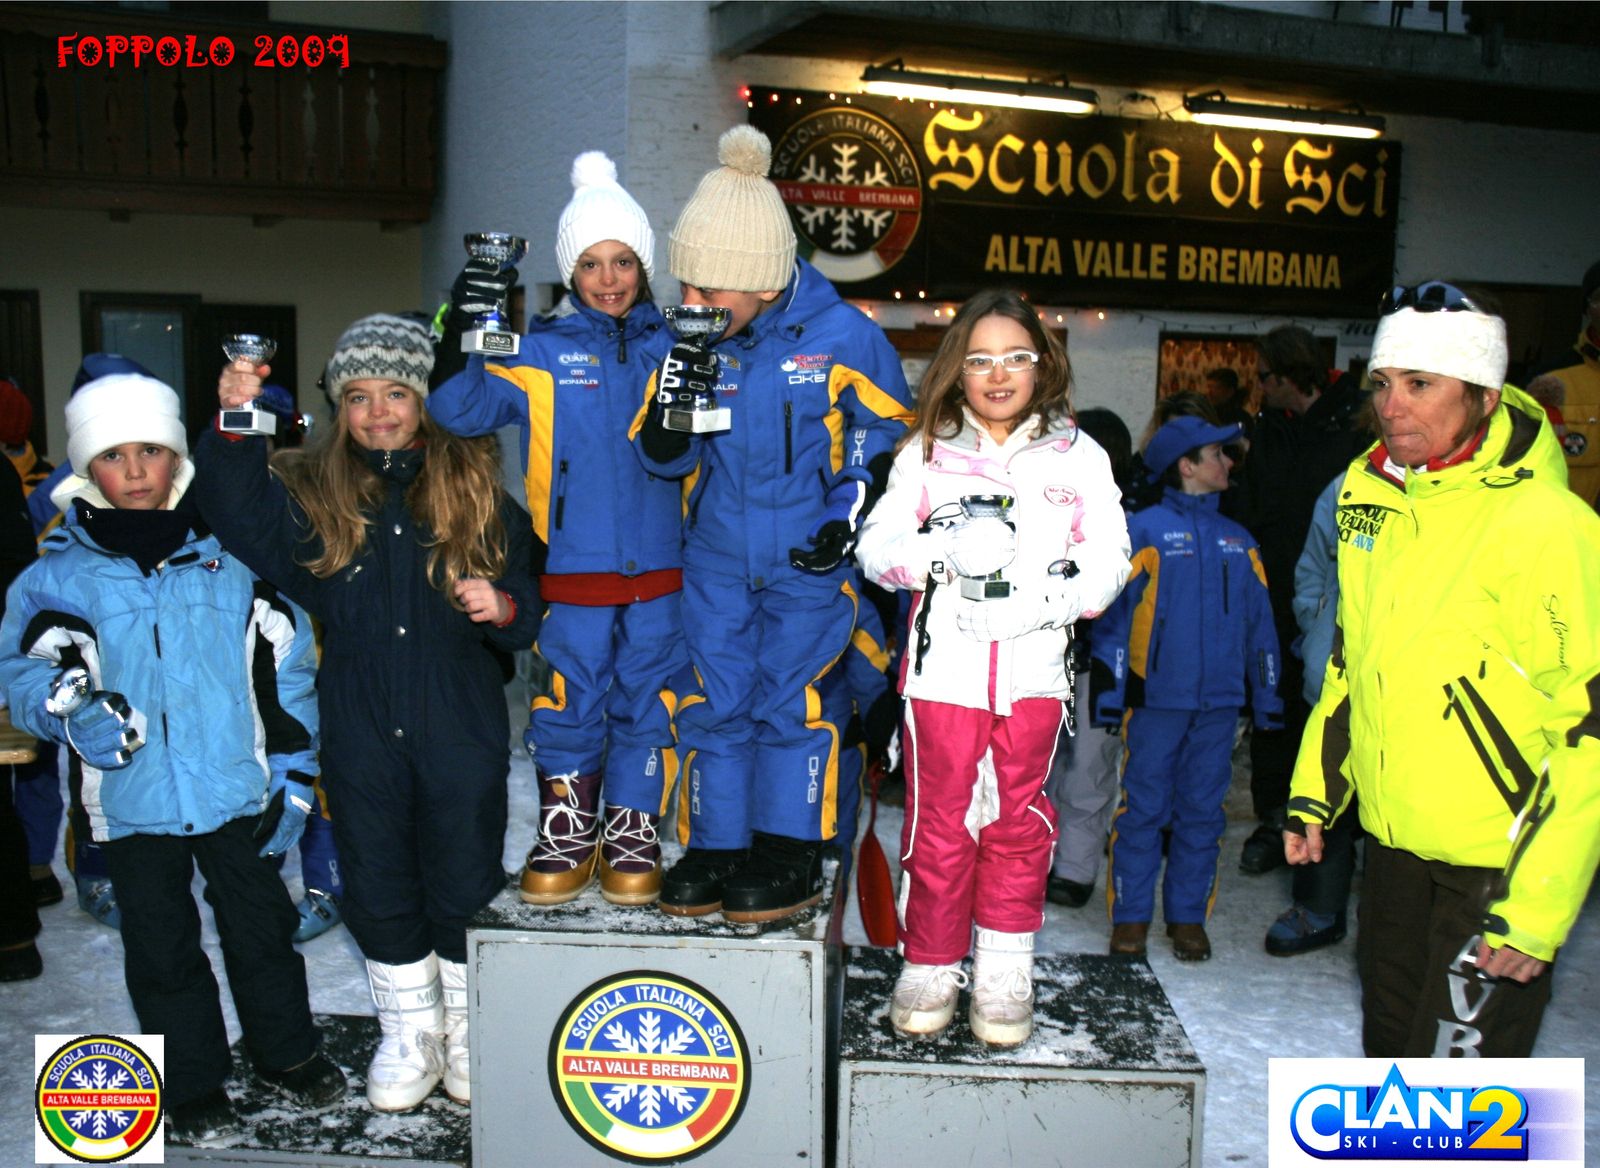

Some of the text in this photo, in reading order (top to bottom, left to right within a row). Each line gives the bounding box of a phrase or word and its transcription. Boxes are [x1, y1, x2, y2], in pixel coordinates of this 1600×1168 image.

[832, 114, 896, 152] ITALIANA
[924, 109, 1388, 218] Scuola di Sci
[781, 187, 915, 205] LTA VALLE BREMBANA
[985, 234, 1341, 289] ALTA VALLE BREMBANA
[1352, 533, 1374, 553] AVB
[572, 985, 731, 1053] SCUOLA ITALIANA SCI
[568, 1058, 730, 1080] ALTA VALLE BREMBANA
